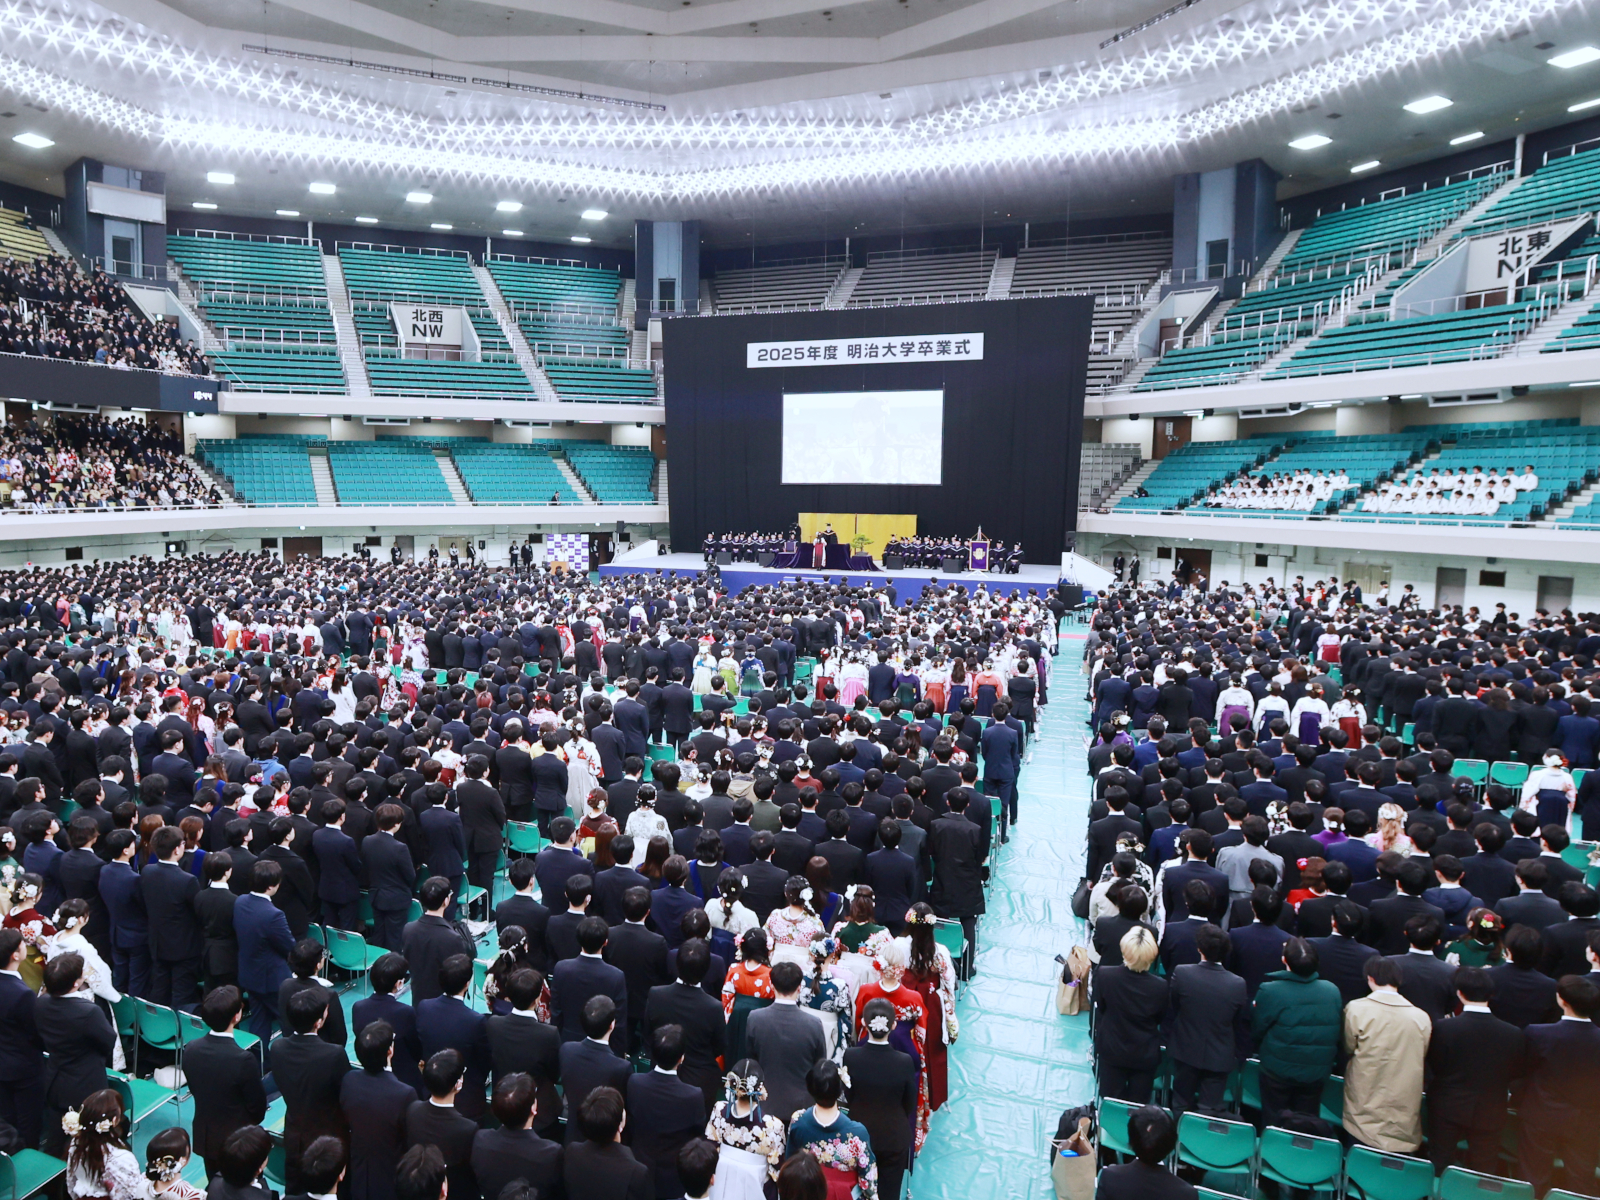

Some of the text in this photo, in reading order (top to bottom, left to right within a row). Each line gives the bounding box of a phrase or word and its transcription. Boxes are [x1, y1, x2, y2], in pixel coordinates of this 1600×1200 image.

[1498, 230, 1552, 256] 北東
[1497, 254, 1535, 278] N
[412, 308, 443, 323] 北西
[412, 324, 443, 337] NW
[757, 339, 971, 362] 2025年度 明治大学卒業式
